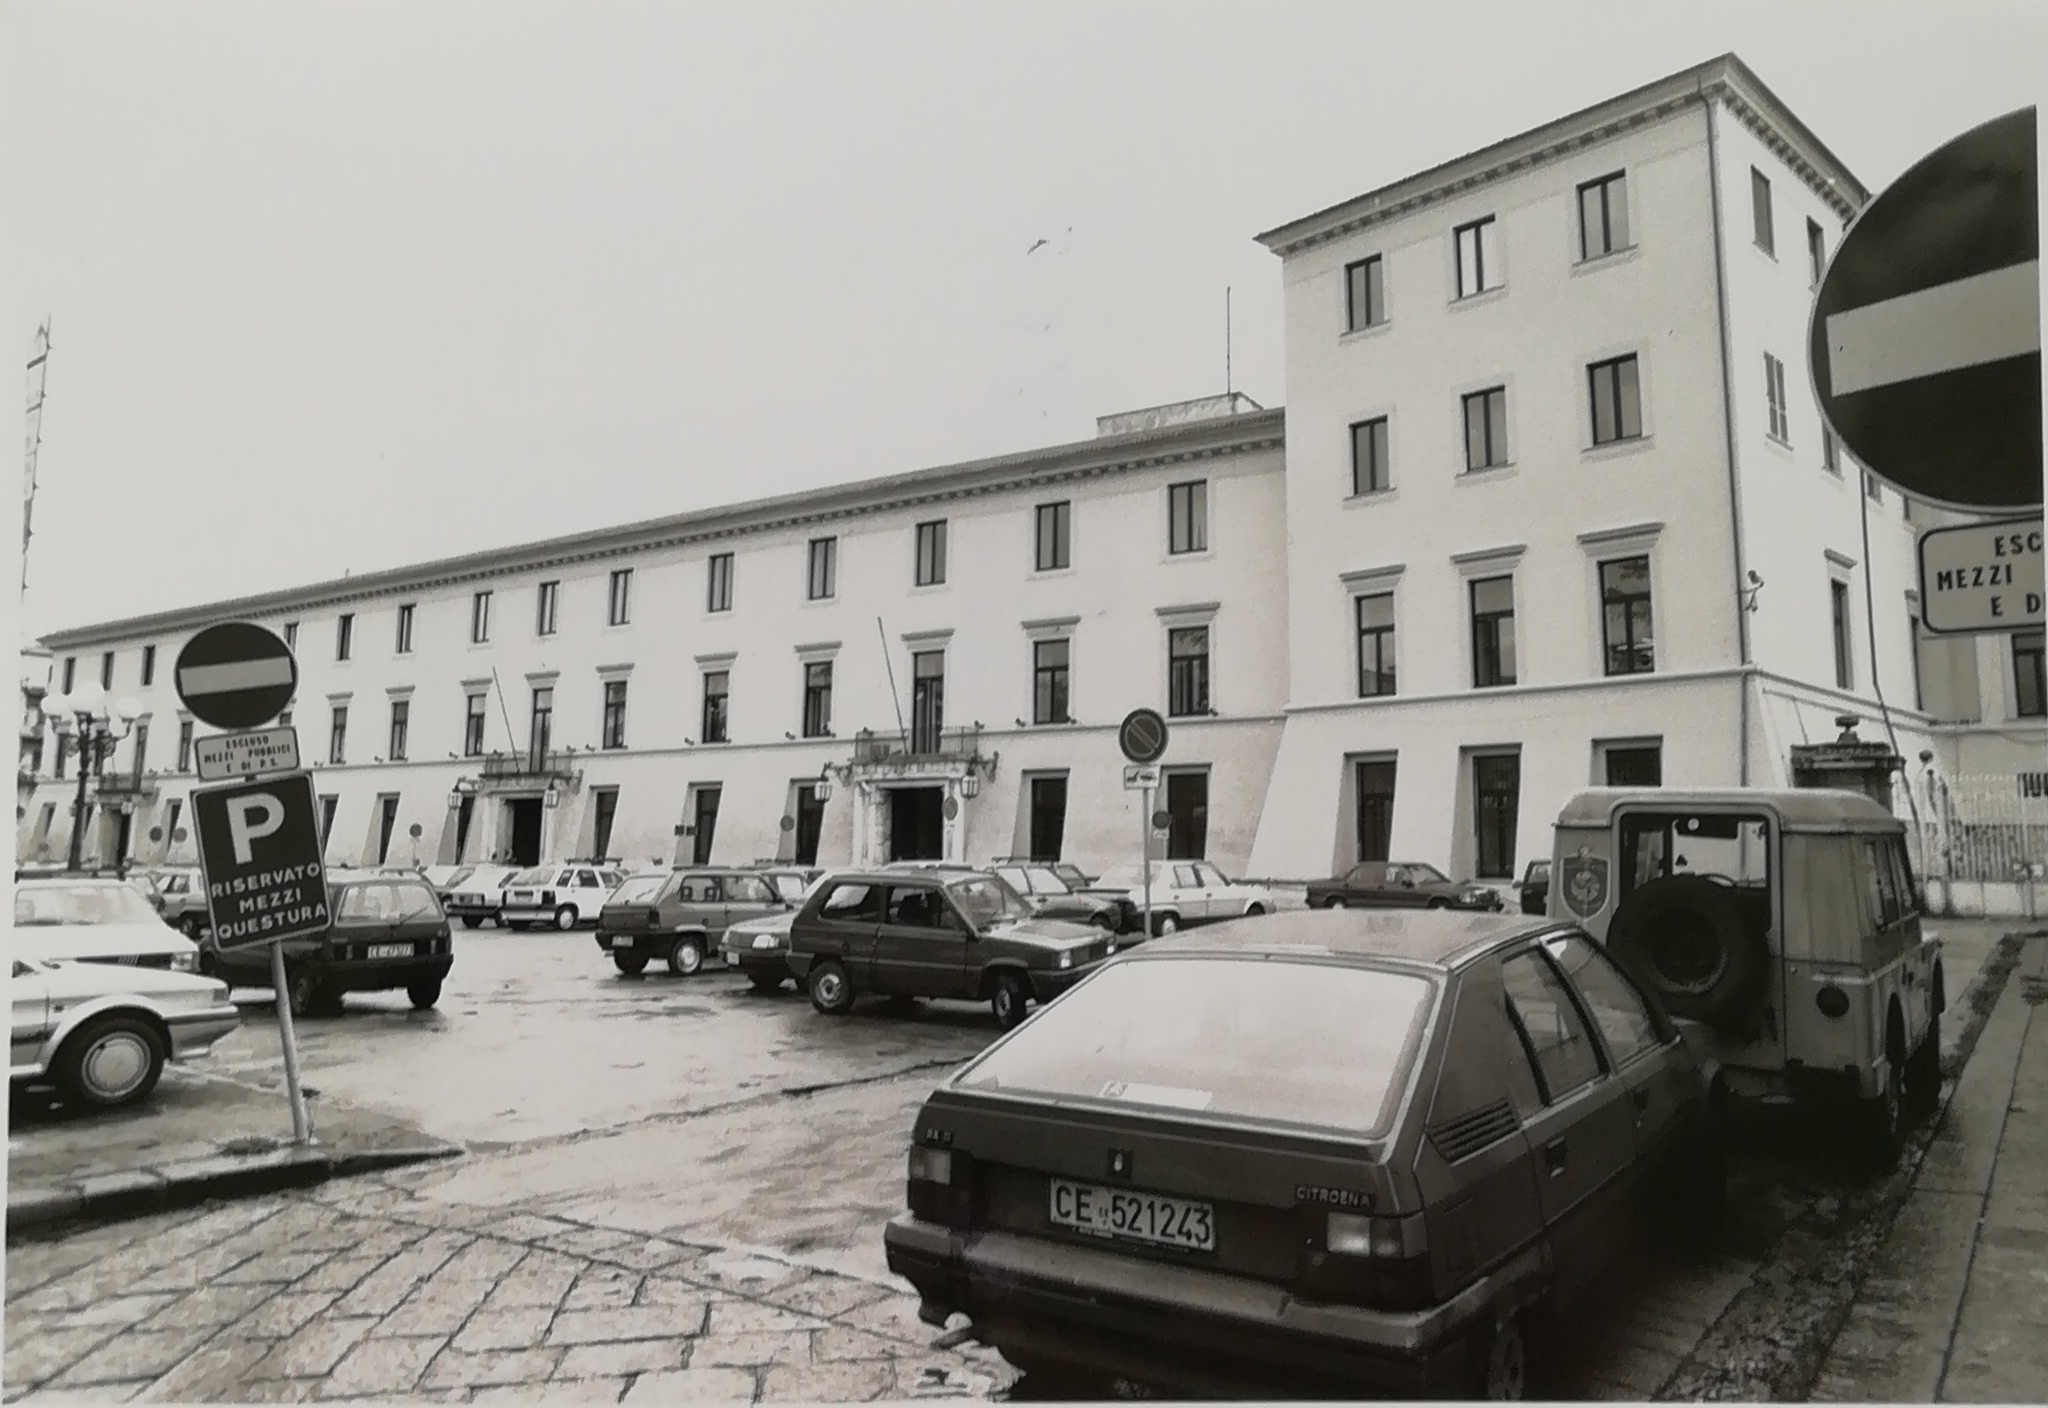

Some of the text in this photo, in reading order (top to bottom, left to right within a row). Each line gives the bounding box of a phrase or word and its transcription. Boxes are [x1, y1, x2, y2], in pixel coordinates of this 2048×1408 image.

[1994, 532, 2043, 557] ESC
[1937, 563, 2013, 592] MEZZI
[1991, 596, 2003, 617] E
[226, 735, 269, 750] ESCLUSO
[204, 751, 234, 764] MEZZI
[226, 792, 285, 866] P
[210, 862, 320, 898] RISERVATO
[239, 888, 302, 915] MEZZI
[218, 904, 326, 940] QUESTURA
[1056, 1185, 1093, 1223] CE
[1111, 1195, 1211, 1244] 521243
